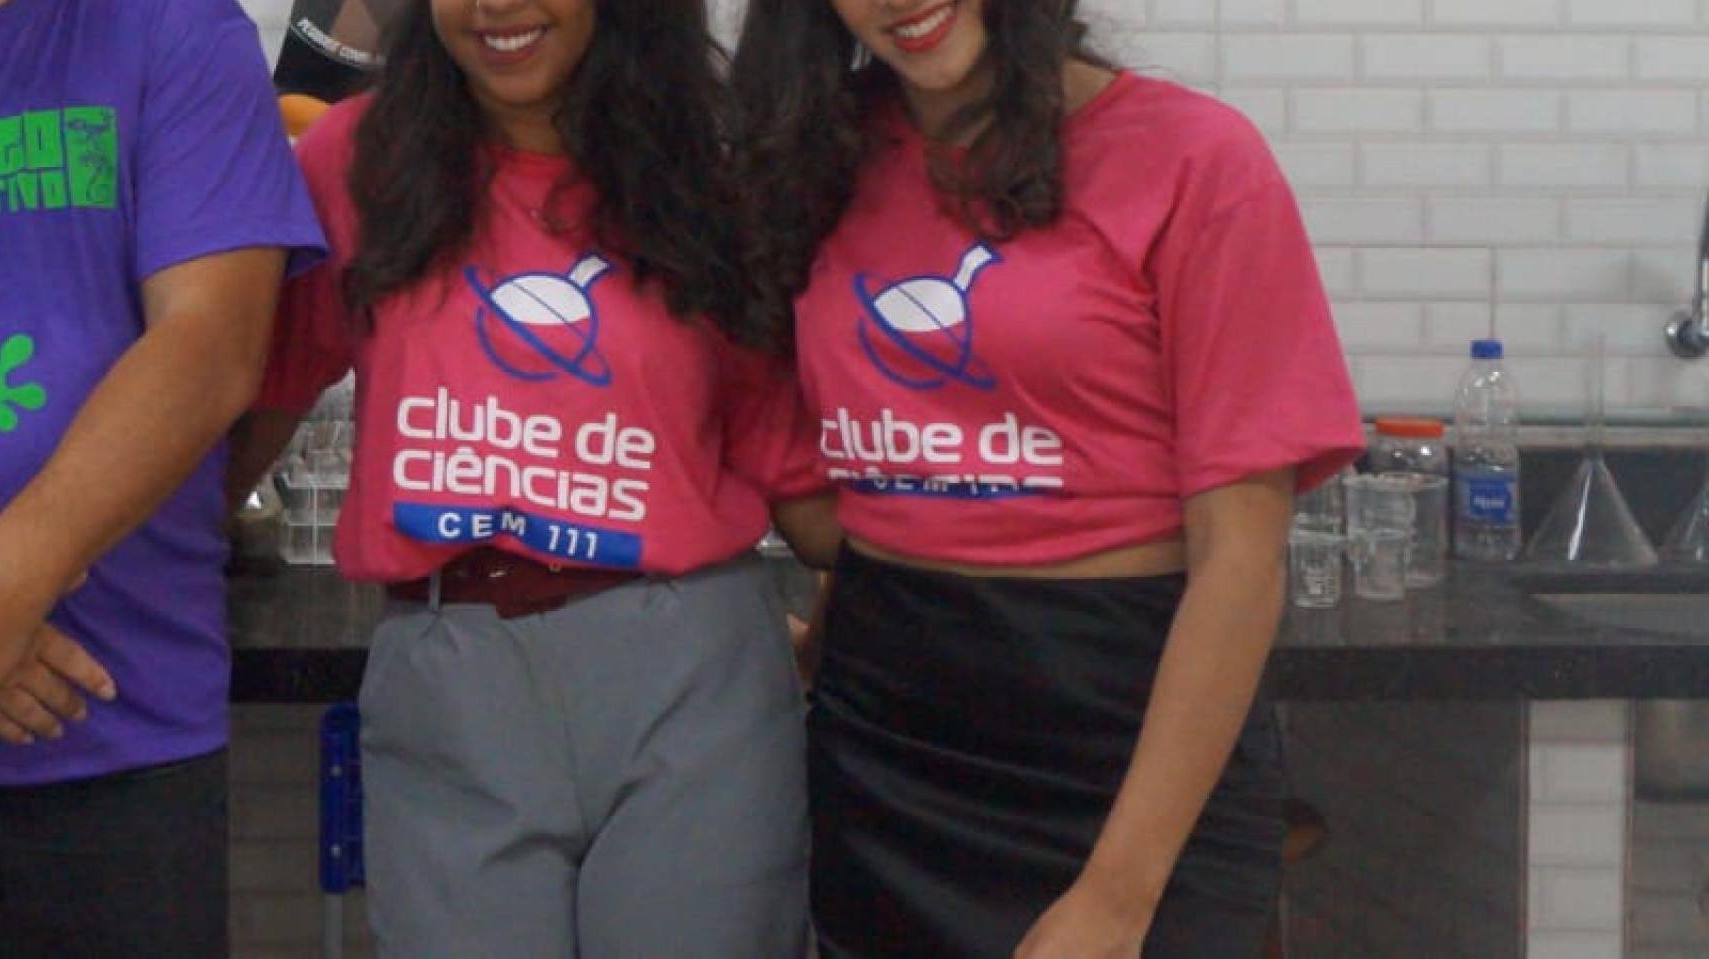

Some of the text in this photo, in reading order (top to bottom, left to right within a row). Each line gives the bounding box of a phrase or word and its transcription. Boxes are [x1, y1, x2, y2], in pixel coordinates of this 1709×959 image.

[574, 412, 656, 469] de
[978, 411, 1064, 466] de
[392, 446, 651, 523] ciências
[437, 512, 598, 559] CEM 111
